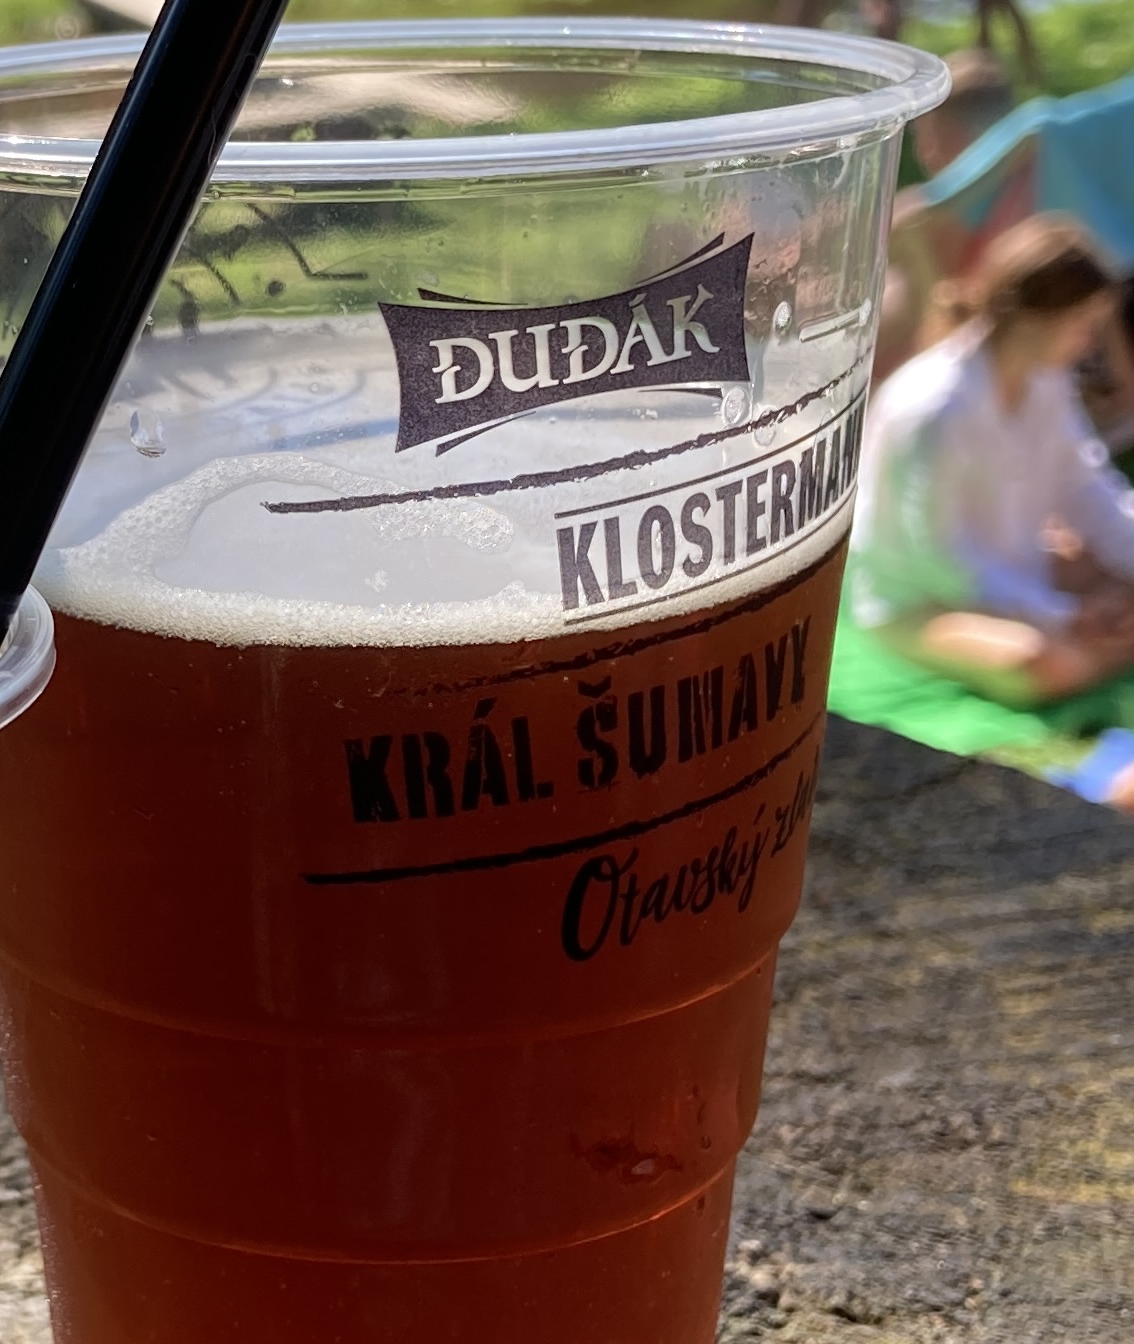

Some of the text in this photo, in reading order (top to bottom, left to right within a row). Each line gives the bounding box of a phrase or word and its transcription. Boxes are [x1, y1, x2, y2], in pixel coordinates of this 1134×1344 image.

[343, 615, 812, 824] KRÁL ŠUMAVY
[561, 802, 770, 962] Otavský
